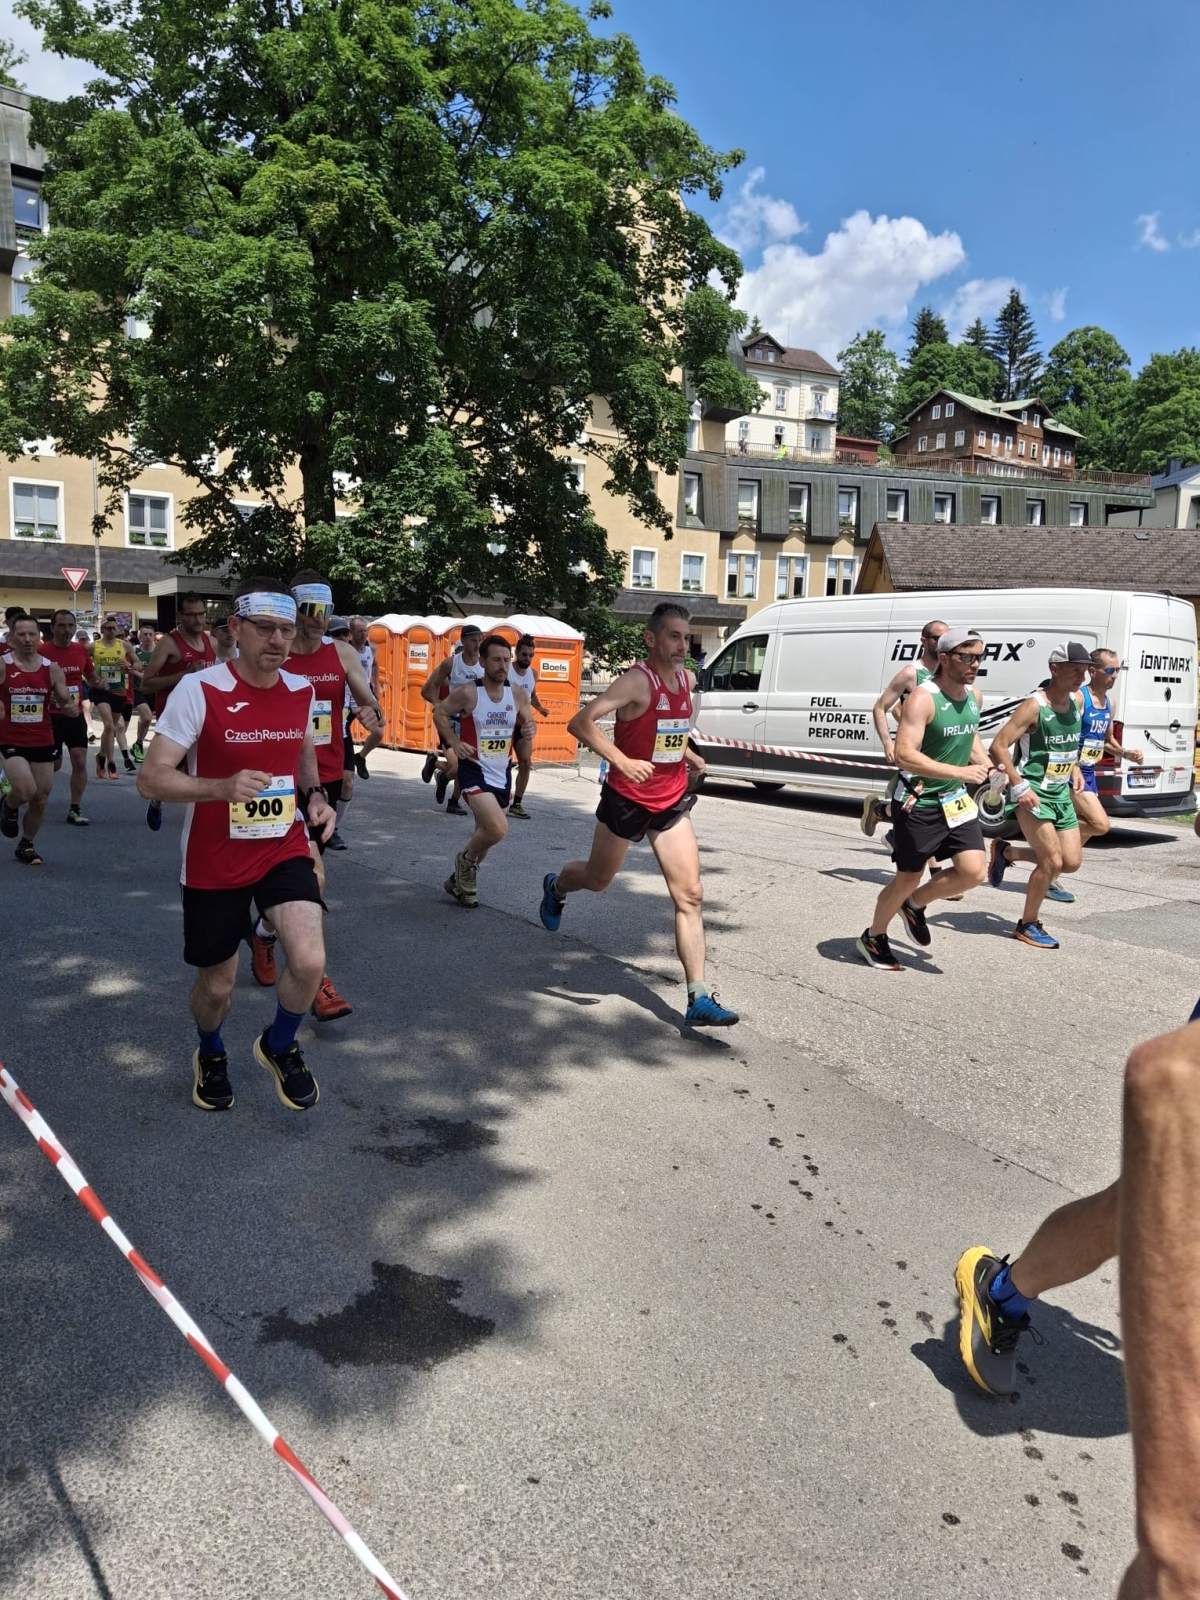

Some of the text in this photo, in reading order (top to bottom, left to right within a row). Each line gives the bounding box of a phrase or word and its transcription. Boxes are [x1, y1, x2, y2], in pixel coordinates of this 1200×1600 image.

[542, 663, 567, 671] Boels
[811, 697, 842, 707] FUEL.
[19, 704, 37, 713] 340
[487, 711, 507, 719] GREAT
[809, 712, 869, 725] HYDRATE.
[1090, 720, 1108, 733] USA
[225, 729, 303, 742] CzechRepublic
[808, 727, 869, 741] PERFORM.
[488, 740, 506, 750] 270
[665, 735, 683, 747] 525
[1055, 763, 1071, 773] 377
[245, 798, 283, 818] 900
